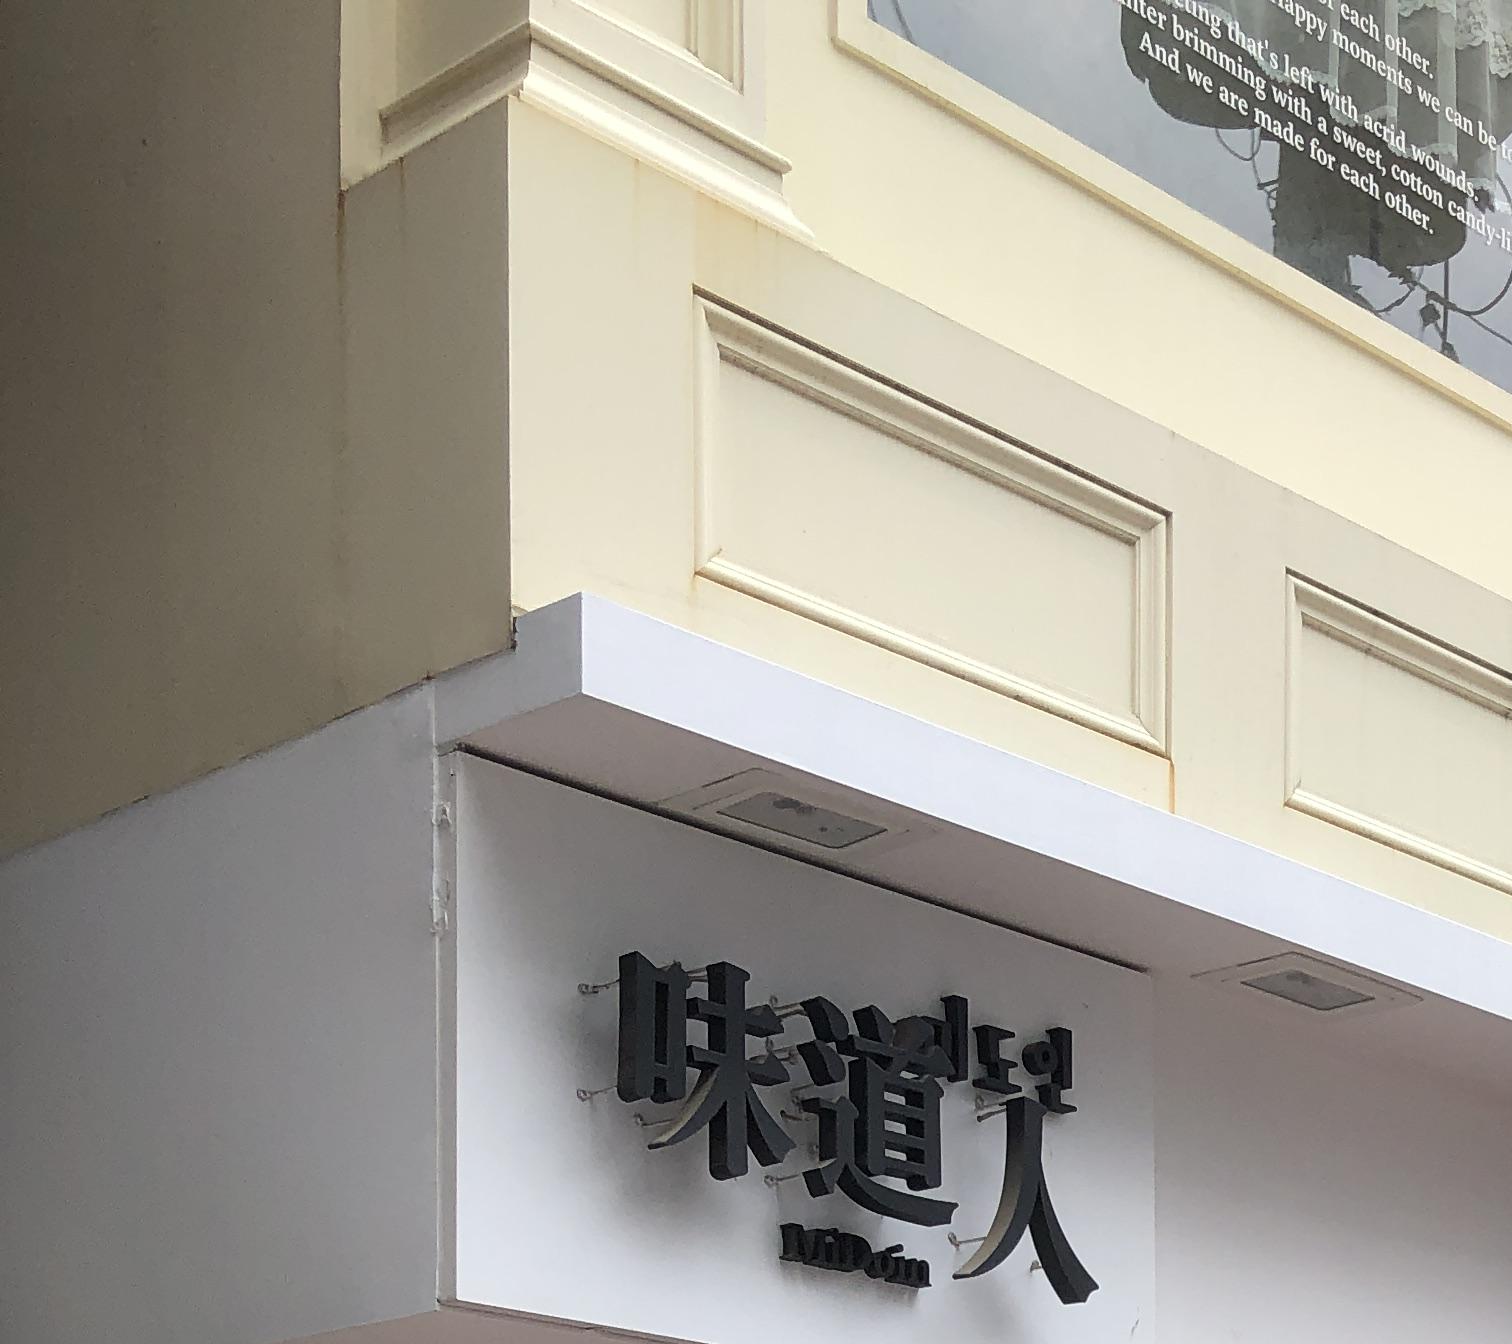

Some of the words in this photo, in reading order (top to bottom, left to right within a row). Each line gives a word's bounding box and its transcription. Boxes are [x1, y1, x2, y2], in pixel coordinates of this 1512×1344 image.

[1139, 31, 1180, 74] And
[1186, 63, 1214, 93] we
[1219, 86, 1249, 116] are
[1254, 107, 1305, 152] made
[1310, 138, 1337, 171] for
[1340, 163, 1381, 201] each
[1385, 191, 1434, 235] other.
[1172, 14, 1267, 101] brimming
[1272, 84, 1312, 126] with
[1318, 117, 1328, 135] a
[1334, 126, 1387, 176] sweet,
[1391, 164, 1444, 210] cotton
[1227, 20, 1279, 70] that's
[1284, 54, 1315, 94] left
[1319, 83, 1358, 123] with
[1364, 114, 1406, 154] acrid
[1411, 144, 1479, 202] wounds.
[1332, 29, 1413, 94] moments
[1417, 85, 1440, 113] we
[1445, 105, 1474, 137] can
[1478, 120, 1497, 152] be
[1340, 3, 1380, 42] each
[1385, 34, 1434, 79] other.
[616, 950, 1100, 1305] 味道人
